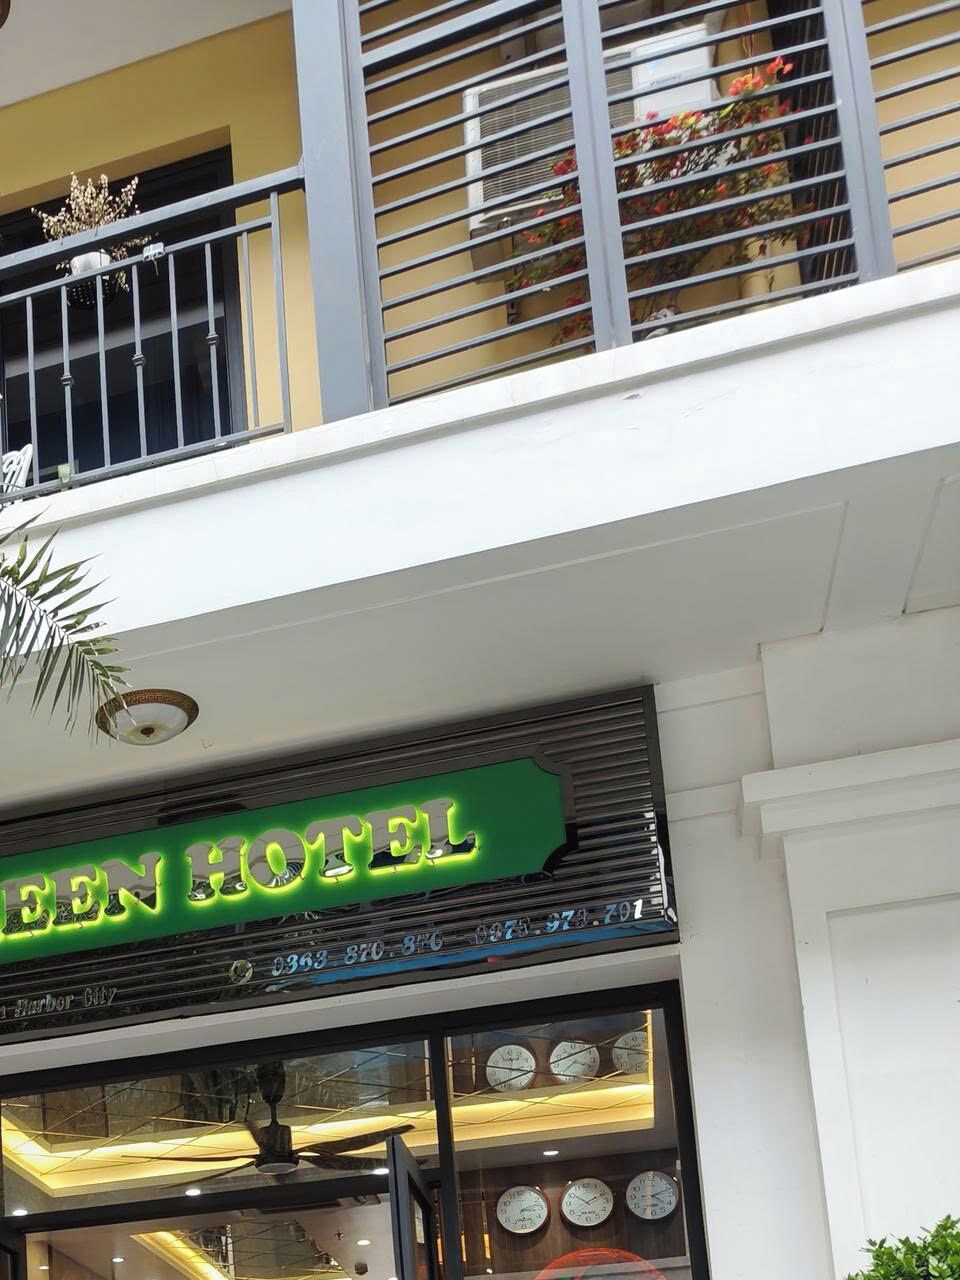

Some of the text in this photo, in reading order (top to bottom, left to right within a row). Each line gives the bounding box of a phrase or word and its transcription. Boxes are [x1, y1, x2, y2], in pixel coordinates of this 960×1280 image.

[185, 798, 478, 905] HOTEL
[14, 994, 74, 1017] Harbor
[84, 986, 117, 1008] City
